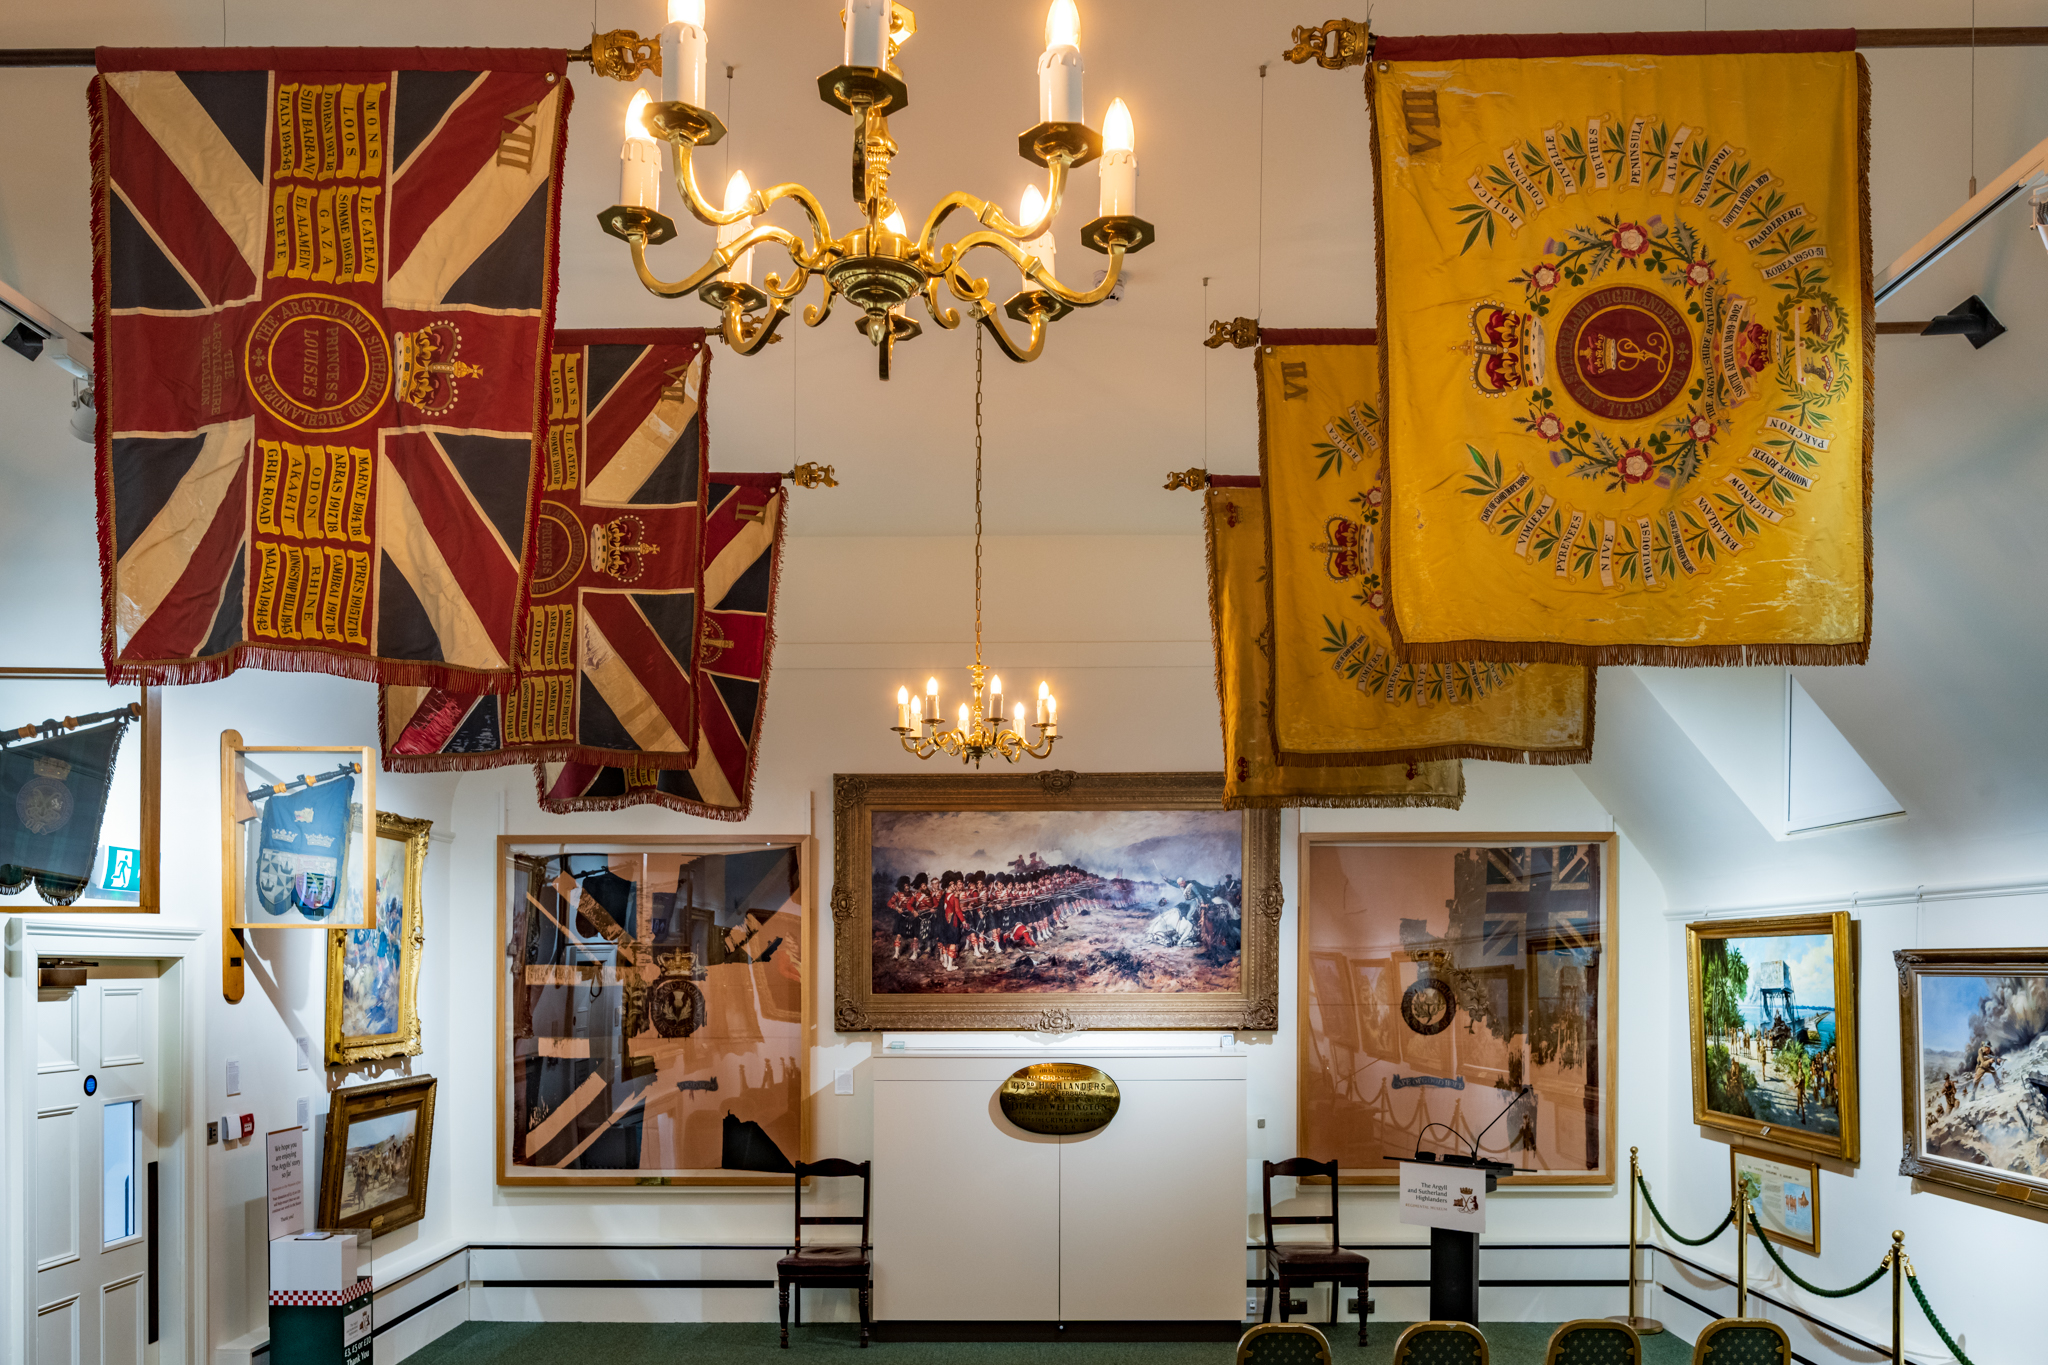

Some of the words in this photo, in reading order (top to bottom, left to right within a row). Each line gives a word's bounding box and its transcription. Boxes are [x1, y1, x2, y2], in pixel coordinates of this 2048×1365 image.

[280, 90, 290, 128] ITALY
[301, 89, 314, 114] SIDI
[323, 92, 333, 134] DOIRAN
[302, 118, 316, 175] BARRANI
[343, 107, 357, 156] LOOS
[366, 101, 379, 158] MONS
[1546, 135, 1574, 188] NIVELLE
[1589, 128, 1606, 180] ORTHES
[1629, 120, 1645, 185] PENINSULA
[1667, 141, 1683, 181] ALMA
[1507, 152, 1544, 206] CORUNNA
[1694, 148, 1732, 206] SEVASTOPOL
[296, 196, 308, 211] EL
[338, 194, 350, 234] SOMME
[360, 196, 372, 214] LE
[1473, 180, 1518, 224] ROLICA
[1722, 203, 1742, 227] SOUTH
[1738, 184, 1758, 206] AFRICA
[274, 204, 286, 260] CRETE
[297, 214, 311, 270] ALAMEIN
[319, 209, 334, 265] GAZA
[362, 218, 376, 274] CATEAU
[1748, 207, 1802, 249] PAARDEBERG
[1764, 259, 1794, 278] KOREA
[1793, 247, 1824, 263] 1950-51
[281, 299, 340, 320] ARGYLL
[342, 308, 371, 334] AND
[1595, 289, 1685, 336] HIGHLANDERS
[1705, 284, 1715, 336] BATTALION
[1724, 304, 1743, 343] 1899-1902
[255, 316, 280, 342] THE
[1559, 301, 1594, 385] SUTHERLAND
[201, 336, 211, 406] BATTALION
[212, 322, 222, 416] ARGYLLSHIRE
[223, 350, 235, 380] THE
[303, 328, 320, 398] LOUISE'S
[324, 326, 340, 402] PRINCESS
[348, 335, 387, 418] SUTHERLAND
[1702, 337, 1715, 400] ARGYLLSHIRE
[1724, 344, 1736, 371] AFRICA
[254, 374, 346, 426] HIGHLANDERS
[552, 370, 561, 404] LOOS
[567, 366, 577, 406] MONS
[1574, 385, 1600, 410] AND
[1664, 369, 1686, 396] THE
[1728, 372, 1746, 398] SOUTH
[1607, 392, 1663, 418] ARGYLL
[1706, 401, 1716, 420] THE
[551, 430, 559, 458] SOMME
[566, 432, 573, 444] LE
[1329, 427, 1358, 459] ROLICA
[1350, 409, 1377, 447] CORUNNA
[1770, 418, 1826, 449] PAKCHON
[264, 448, 278, 484] GRIK
[332, 454, 347, 493] ARRAS
[355, 456, 370, 501] MARNE
[566, 446, 576, 482] CATEAU
[1752, 448, 1779, 472] RIVER
[1778, 464, 1809, 488] MODDER
[260, 487, 274, 525] ROAD
[284, 458, 302, 523] AKARIT
[307, 467, 322, 518] ODON
[1481, 507, 1494, 522] CAPE
[1488, 500, 1498, 510] OF
[1494, 492, 1508, 504] GOOD
[1504, 483, 1519, 496] HOPE
[1729, 477, 1774, 519] LUCKNOW
[1518, 504, 1550, 546] VIMIERA
[1697, 496, 1739, 550] BALAKLAVA
[542, 522, 552, 574] PRINCESS
[1556, 515, 1582, 572] PYRENEES
[1602, 534, 1614, 571] NIVE
[1642, 521, 1653, 581] TOULOUSE
[1676, 544, 1688, 560] AFRICA
[261, 548, 276, 596] MALAYA
[286, 549, 301, 593] LONGSTOP
[330, 554, 343, 599] CAMBRAI
[352, 556, 367, 594] YPRES
[1681, 558, 1696, 575] SOUTH
[282, 592, 296, 613] HILL
[304, 566, 321, 621] RHINE
[280, 614, 292, 635] 1943
[533, 620, 543, 657] ODON
[549, 611, 557, 638] ARRAS
[563, 609, 572, 640] MARNE
[1359, 654, 1382, 684] VIMIERA
[1387, 662, 1403, 699] PYRENEE
[1417, 668, 1426, 695] NIVE
[522, 680, 530, 710] LONGSTOP
[534, 690, 544, 729] RHINE
[564, 679, 572, 705] YPRES
[1040, 1082, 1106, 1090] HIGHLANDERS
[1011, 1102, 1037, 1111] DUKE
[1050, 1103, 1107, 1111] WELLINGTON
[282, 1151, 297, 1160] enjoying
[1416, 1195, 1448, 1203] Highlanders
[1418, 1189, 1448, 1197] Sutherland
[346, 1354, 360, 1365] Thank
[361, 1350, 370, 1360] You
[358, 1341, 363, 1349] or
